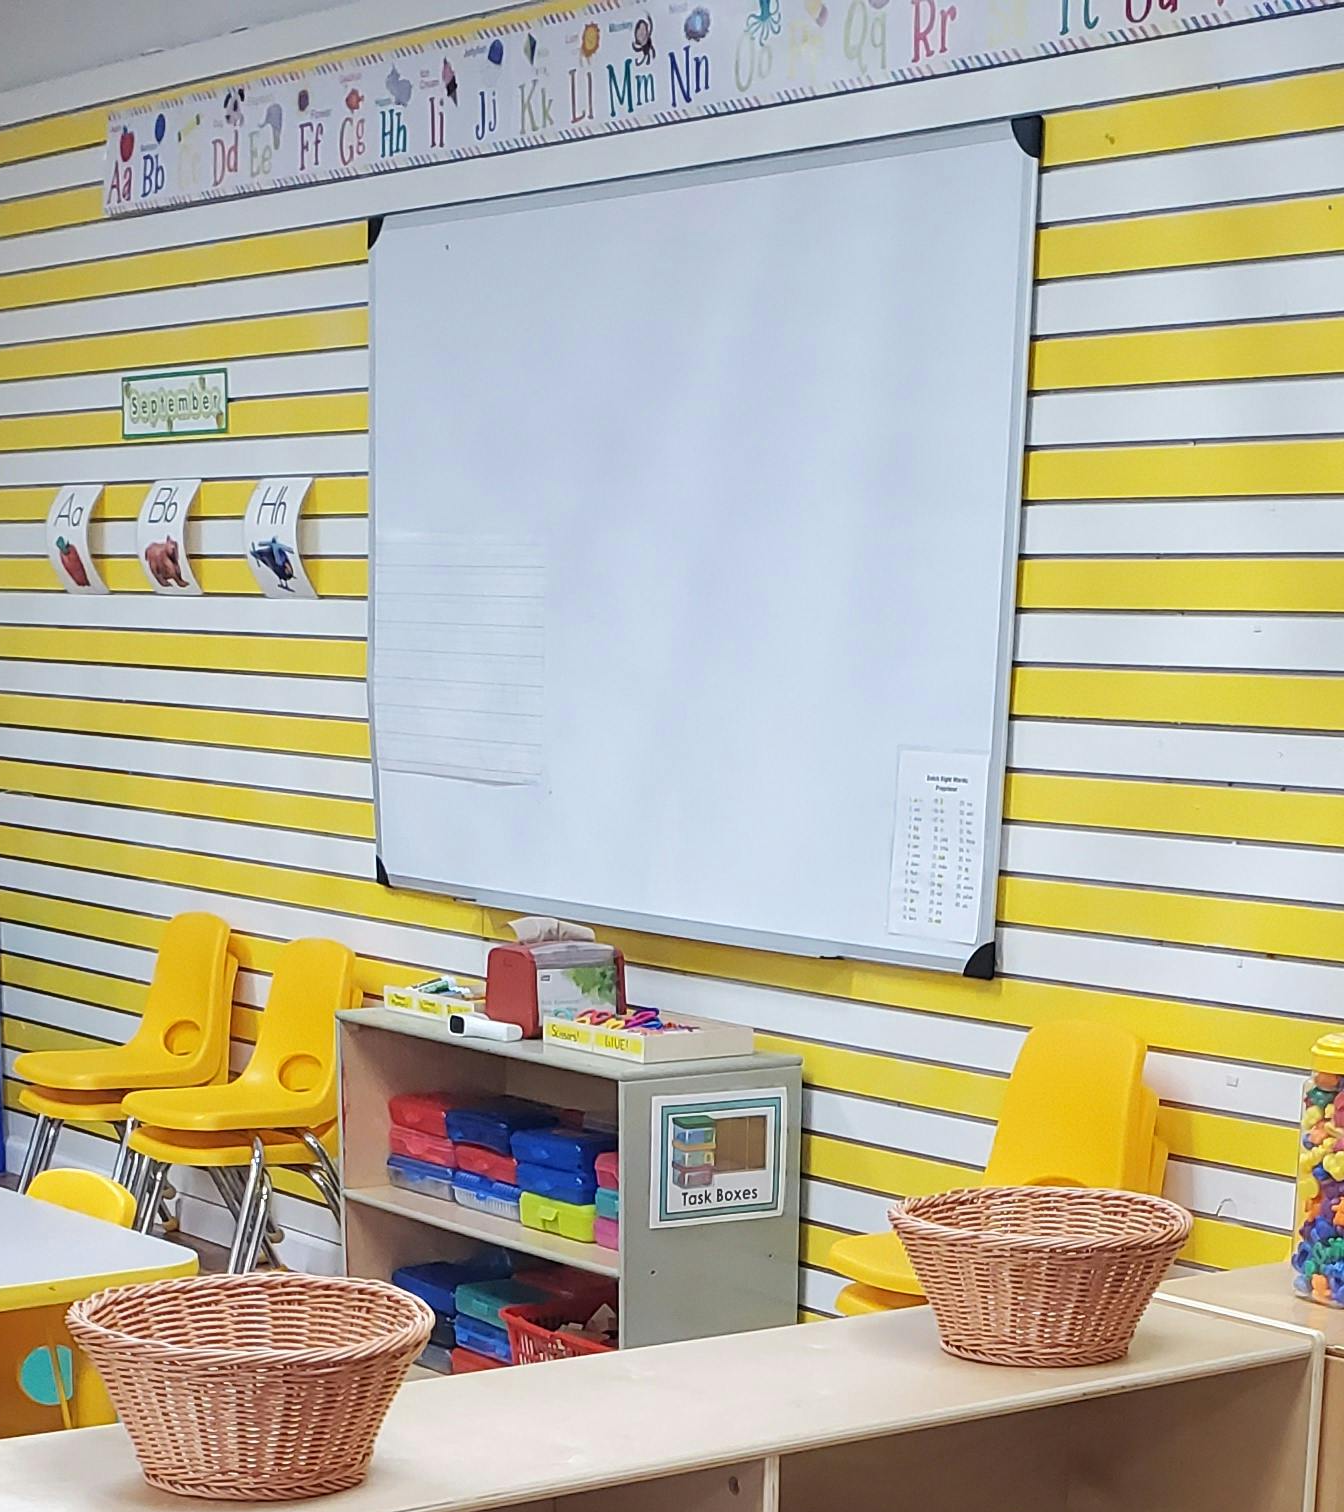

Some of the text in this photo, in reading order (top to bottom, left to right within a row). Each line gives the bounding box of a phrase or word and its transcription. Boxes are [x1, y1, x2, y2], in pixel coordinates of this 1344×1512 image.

[106, 160, 133, 204] Aa
[141, 153, 165, 198] Bb
[211, 130, 239, 187] Dd
[248, 130, 273, 178] Ee
[299, 121, 324, 171] Ff
[339, 116, 366, 167] Gg
[380, 108, 407, 159] Hh
[429, 97, 445, 149] Ii
[475, 90, 498, 141] Jj
[518, 78, 554, 135] Kk
[568, 68, 595, 124] Ll
[606, 58, 656, 118] Mm
[668, 45, 710, 109] Nn
[734, 31, 773, 93] Oo
[911, 0, 957, 64] Rr
[131, 391, 220, 417] September
[56, 493, 84, 527] Aa
[148, 486, 180, 524] Bb
[256, 484, 289, 526] Hh
[681, 1188, 758, 1207] Task Boxes
